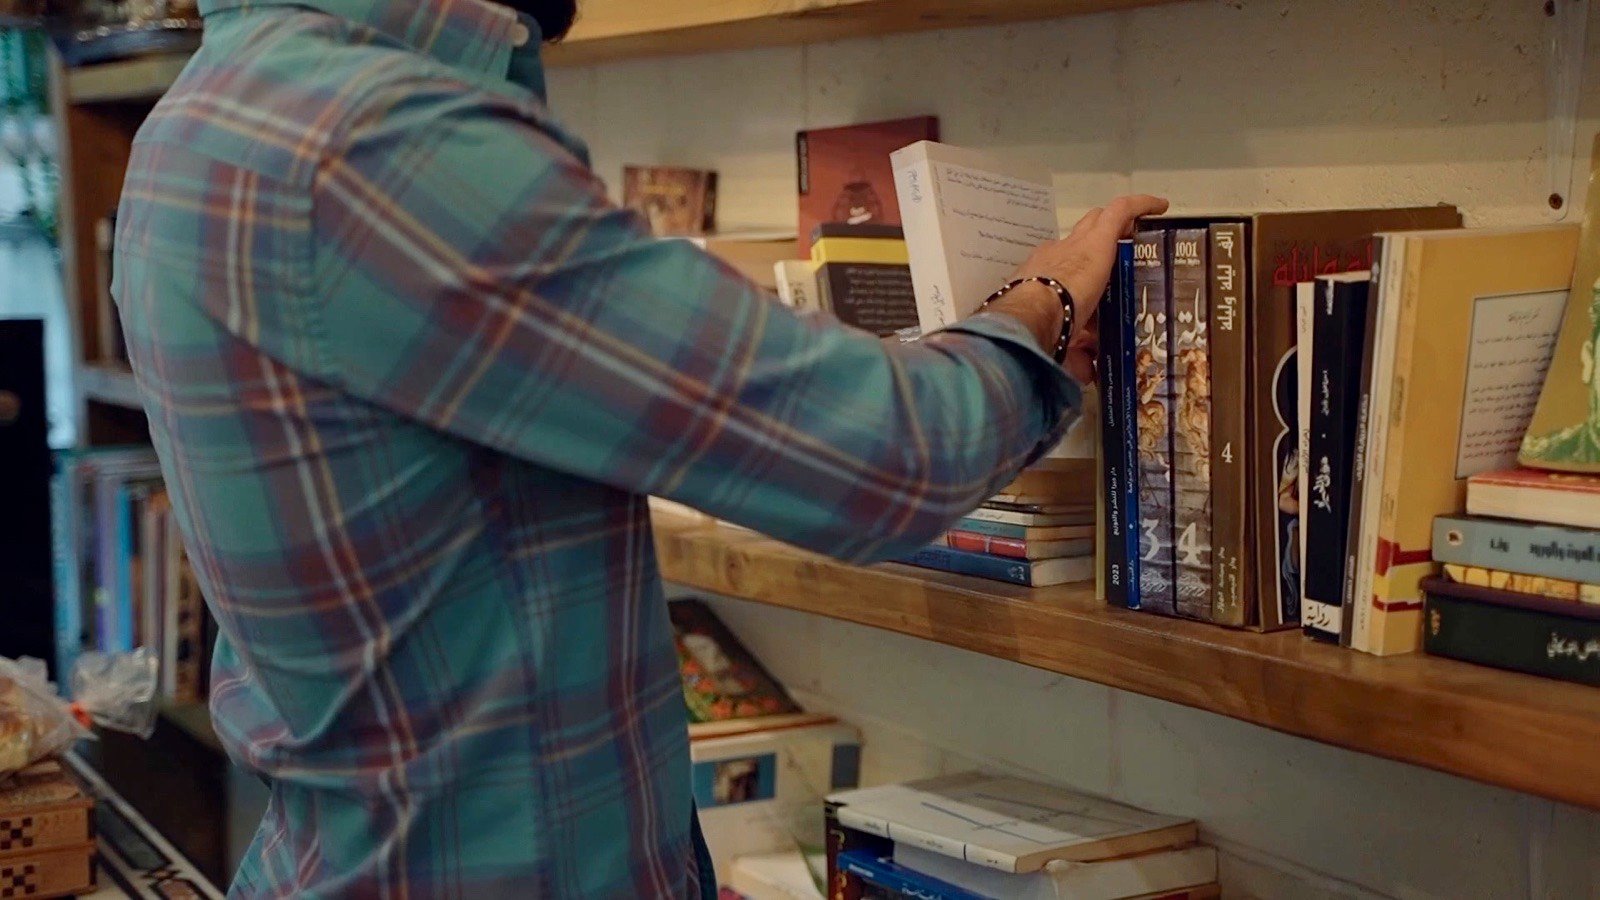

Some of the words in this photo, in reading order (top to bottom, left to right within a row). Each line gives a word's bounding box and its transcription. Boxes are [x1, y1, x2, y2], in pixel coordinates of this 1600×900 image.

[1134, 244, 1158, 259] 1001
[1175, 241, 1198, 258] 1001
[1221, 442, 1233, 463] 4
[1142, 518, 1161, 561] 3
[1177, 522, 1201, 566] 4
[1111, 564, 1120, 586] 2023
